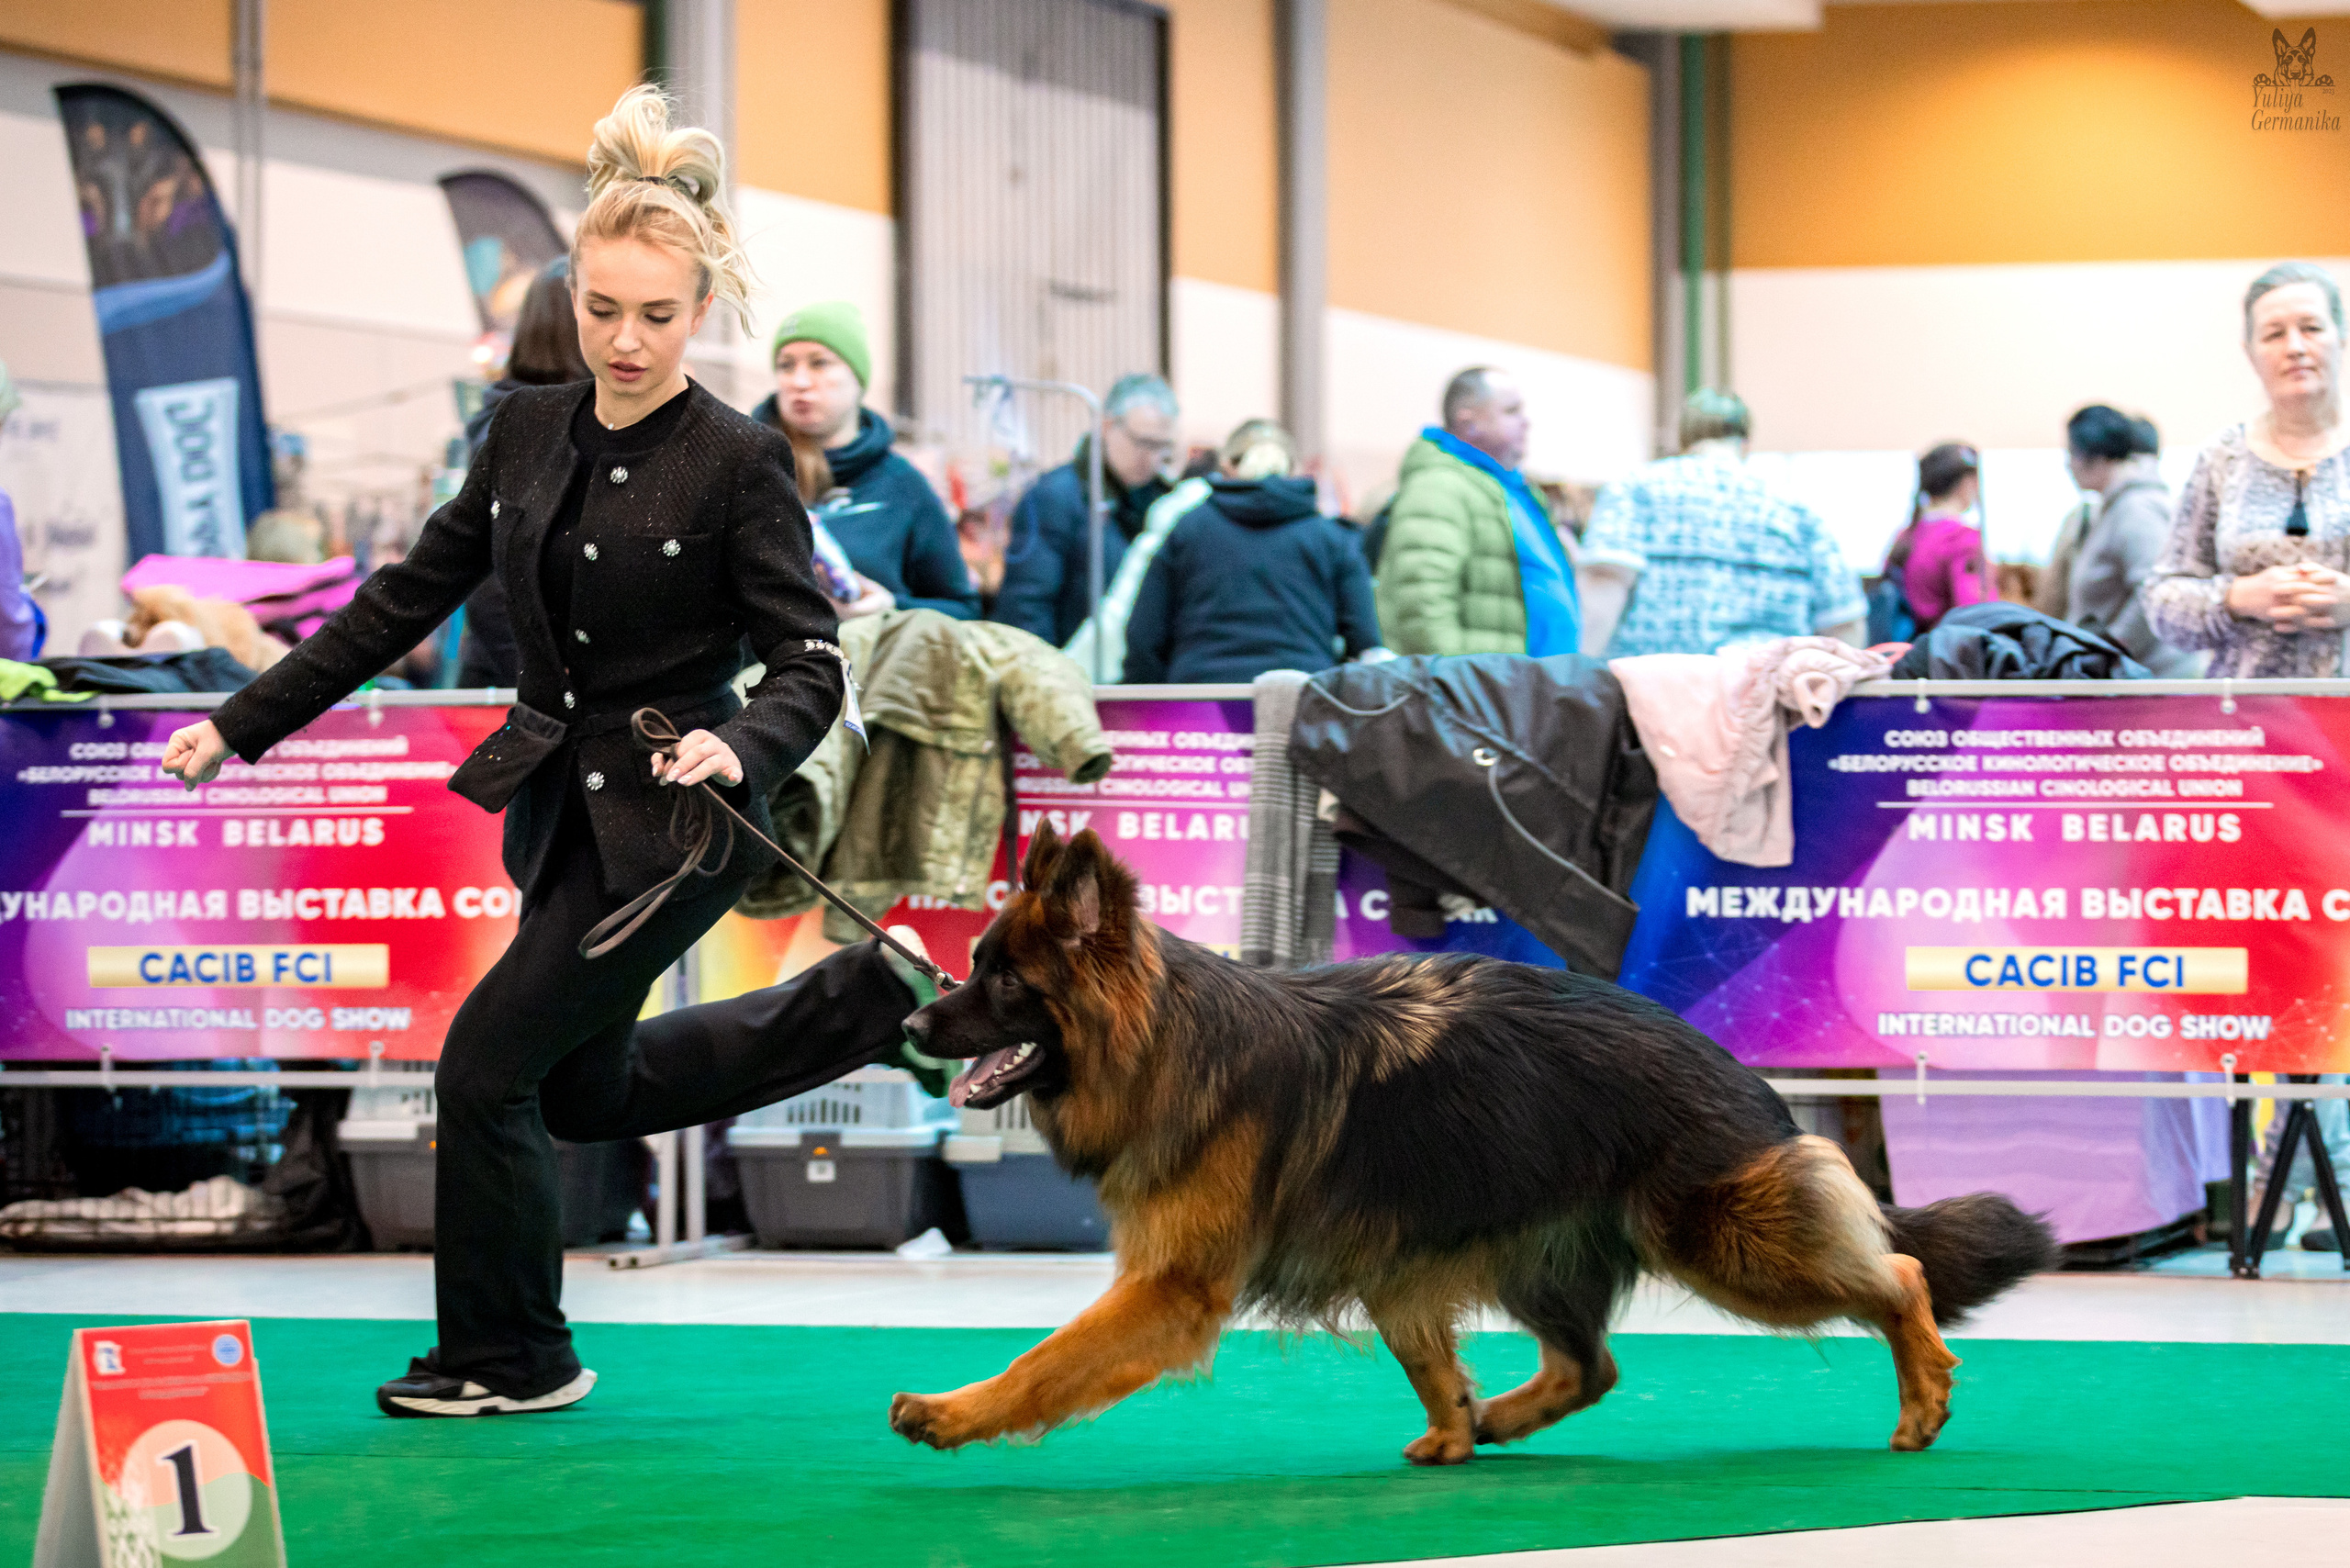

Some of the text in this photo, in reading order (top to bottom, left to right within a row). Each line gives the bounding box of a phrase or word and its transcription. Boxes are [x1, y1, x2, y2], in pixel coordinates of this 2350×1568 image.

[1885, 730, 1949, 748] СОЮЗ
[1906, 778, 2244, 798] BELORUSSIAN CINOLOGICAL UNION
[88, 817, 385, 847] MINSK BELARUS
[1019, 809, 1250, 841] NSK BELAR
[1908, 813, 2243, 843] MINSK BELARUS
[0, 889, 228, 924] УНАРОДНАЯ
[238, 886, 447, 921] ВЫСТАВКА
[1686, 886, 2068, 924] МЕЖДУНАРОДНАЯ
[2080, 887, 2312, 922] ВЫСТАВКА
[139, 951, 332, 984] CACIB FCI
[1964, 953, 2186, 989] CACIB FCI
[65, 1006, 411, 1031] INTERNATIONAL DOG SHOW
[1876, 1012, 2273, 1040] INTERNATIONAL DOG SHOW
[160, 1442, 216, 1537] 1
